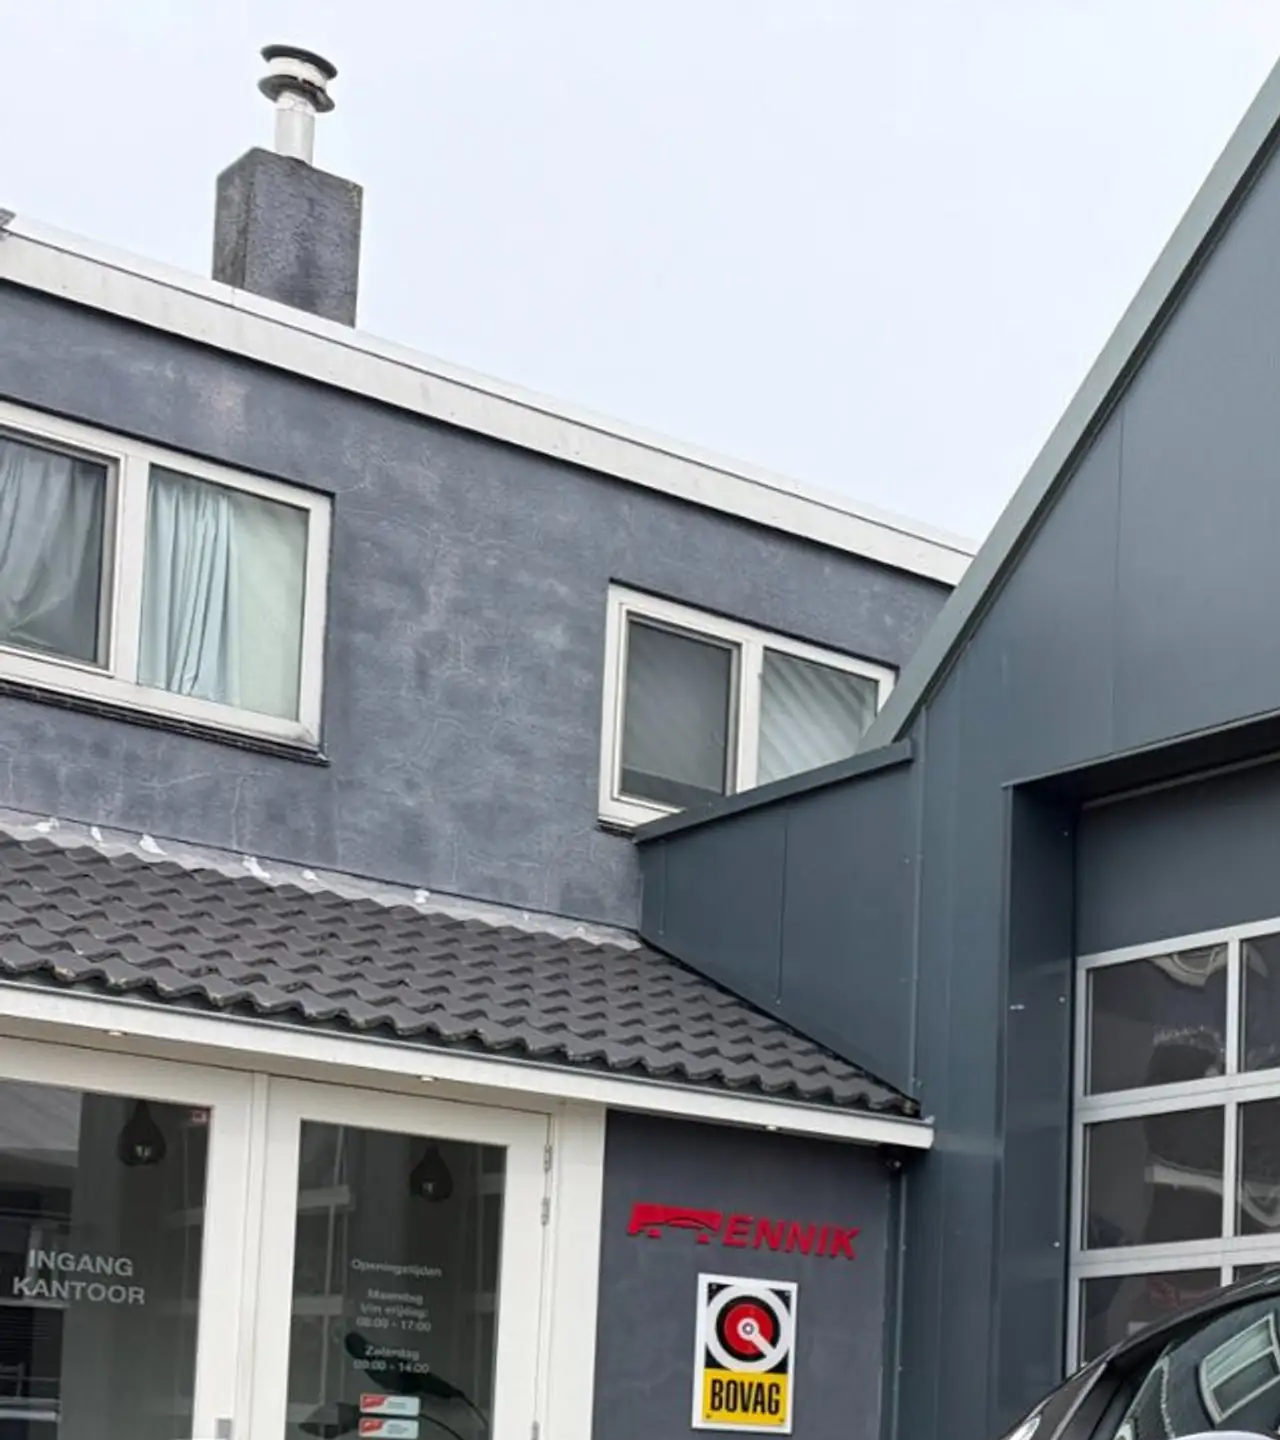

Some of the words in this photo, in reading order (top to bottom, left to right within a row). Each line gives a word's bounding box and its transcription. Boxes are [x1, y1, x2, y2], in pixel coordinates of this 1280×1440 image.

[28, 1249, 133, 1276] INGANG
[12, 1276, 146, 1305] KANTOOR
[711, 1378, 780, 1415] BOVAG
